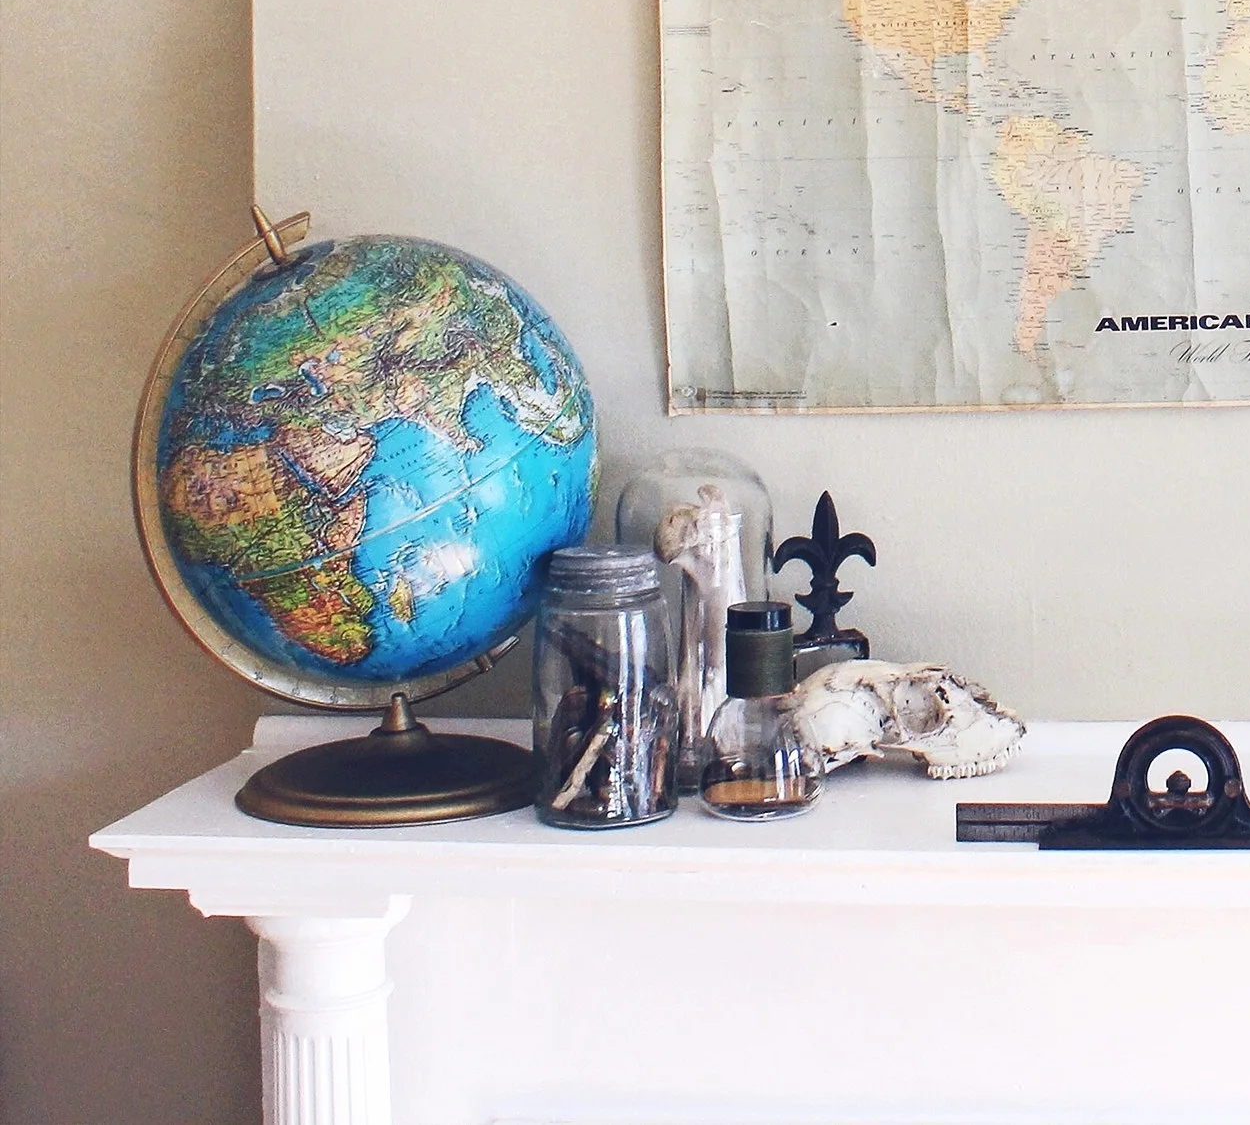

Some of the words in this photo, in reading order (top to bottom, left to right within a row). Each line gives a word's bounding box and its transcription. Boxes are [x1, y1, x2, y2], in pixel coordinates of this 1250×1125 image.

[1030, 50, 1174, 62] ATLANTIC
[727, 117, 883, 128] PACIFIC
[751, 247, 859, 257] OCEAN
[1169, 341, 1226, 364] World
